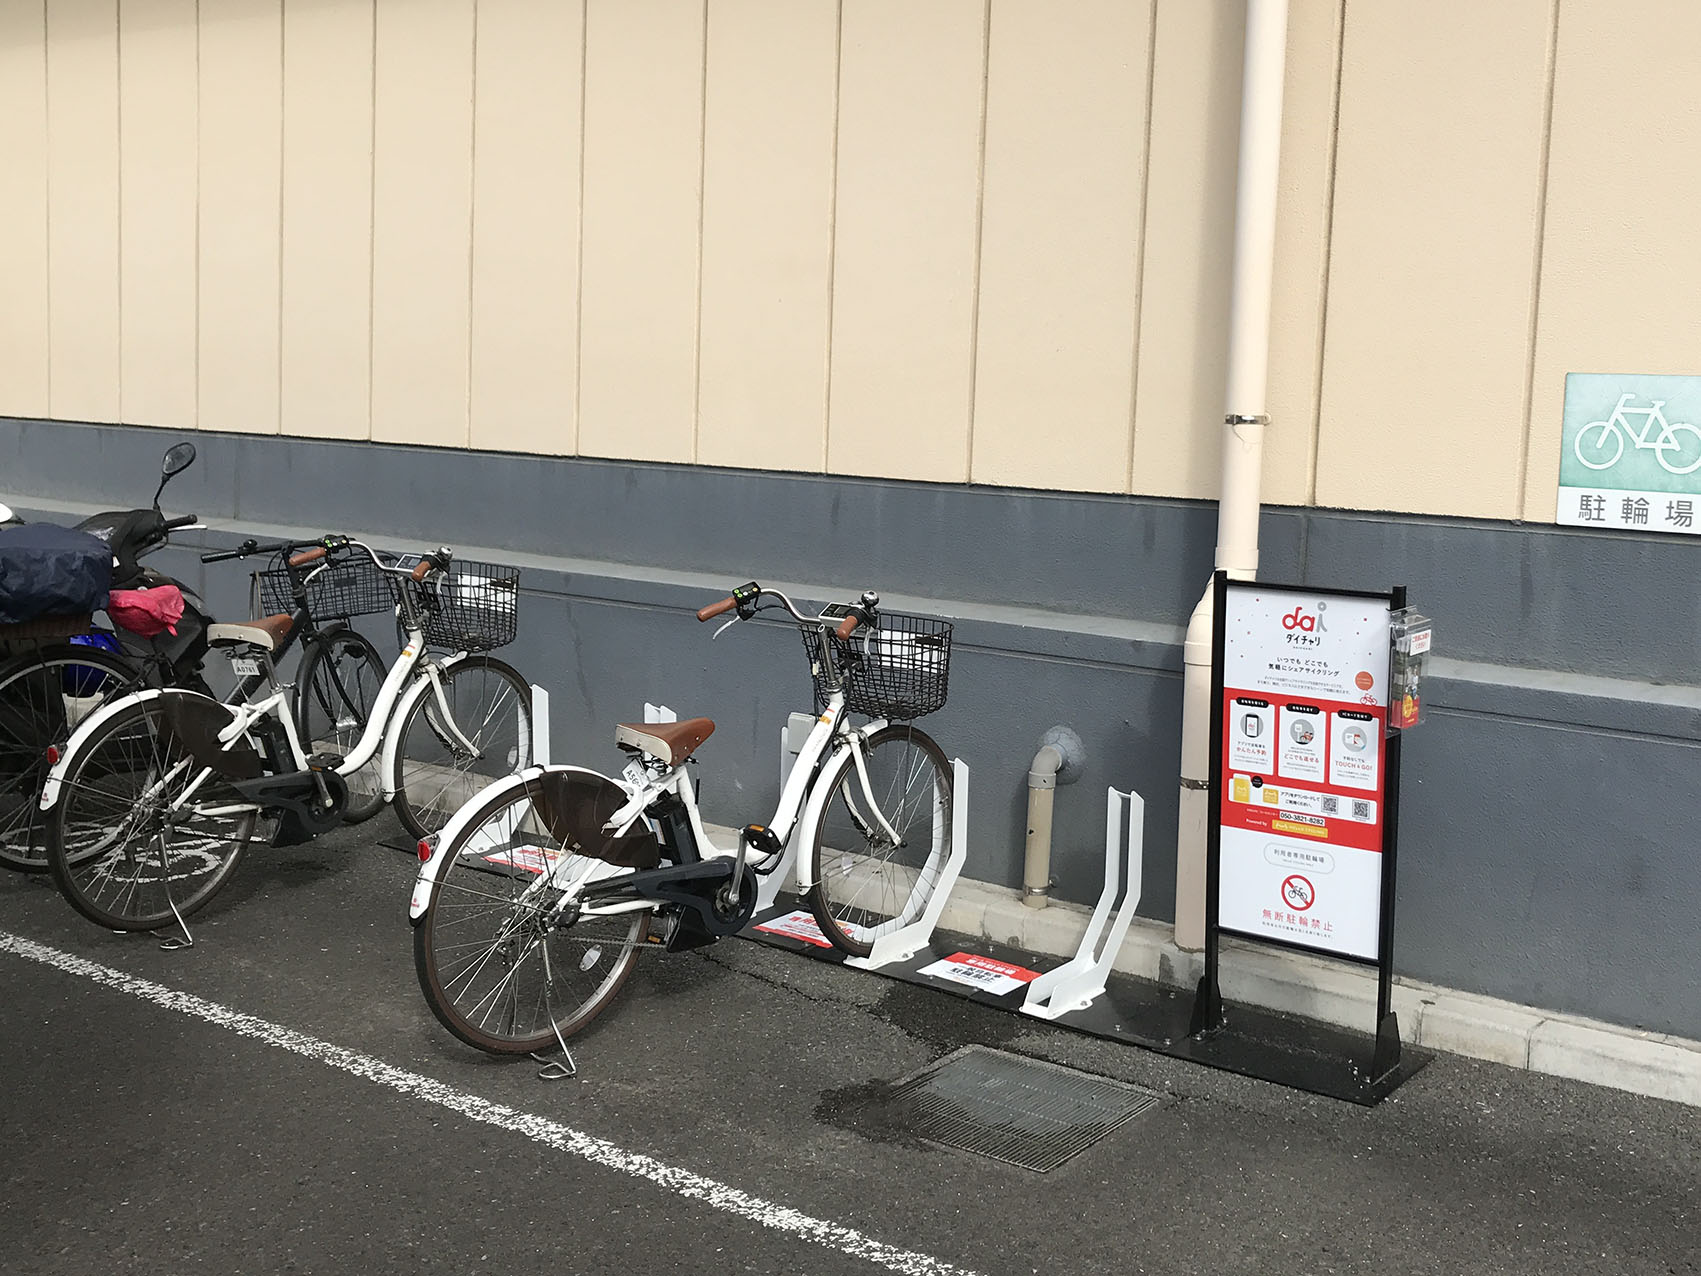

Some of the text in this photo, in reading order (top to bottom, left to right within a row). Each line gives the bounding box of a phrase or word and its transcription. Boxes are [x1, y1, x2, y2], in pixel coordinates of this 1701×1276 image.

[1578, 494, 1694, 528] 駐輪場
[1282, 601, 1328, 632] dai
[1286, 633, 1321, 646] ダイチャリ
[1277, 657, 1328, 668] いつでも どこでも
[1268, 663, 1340, 677] 気軽にシェアサイクリング
[1335, 760, 1356, 769] TOUCH
[1280, 812, 1324, 825] 050-3821-8282
[1263, 909, 1333, 932] 無断駐輪禁止
